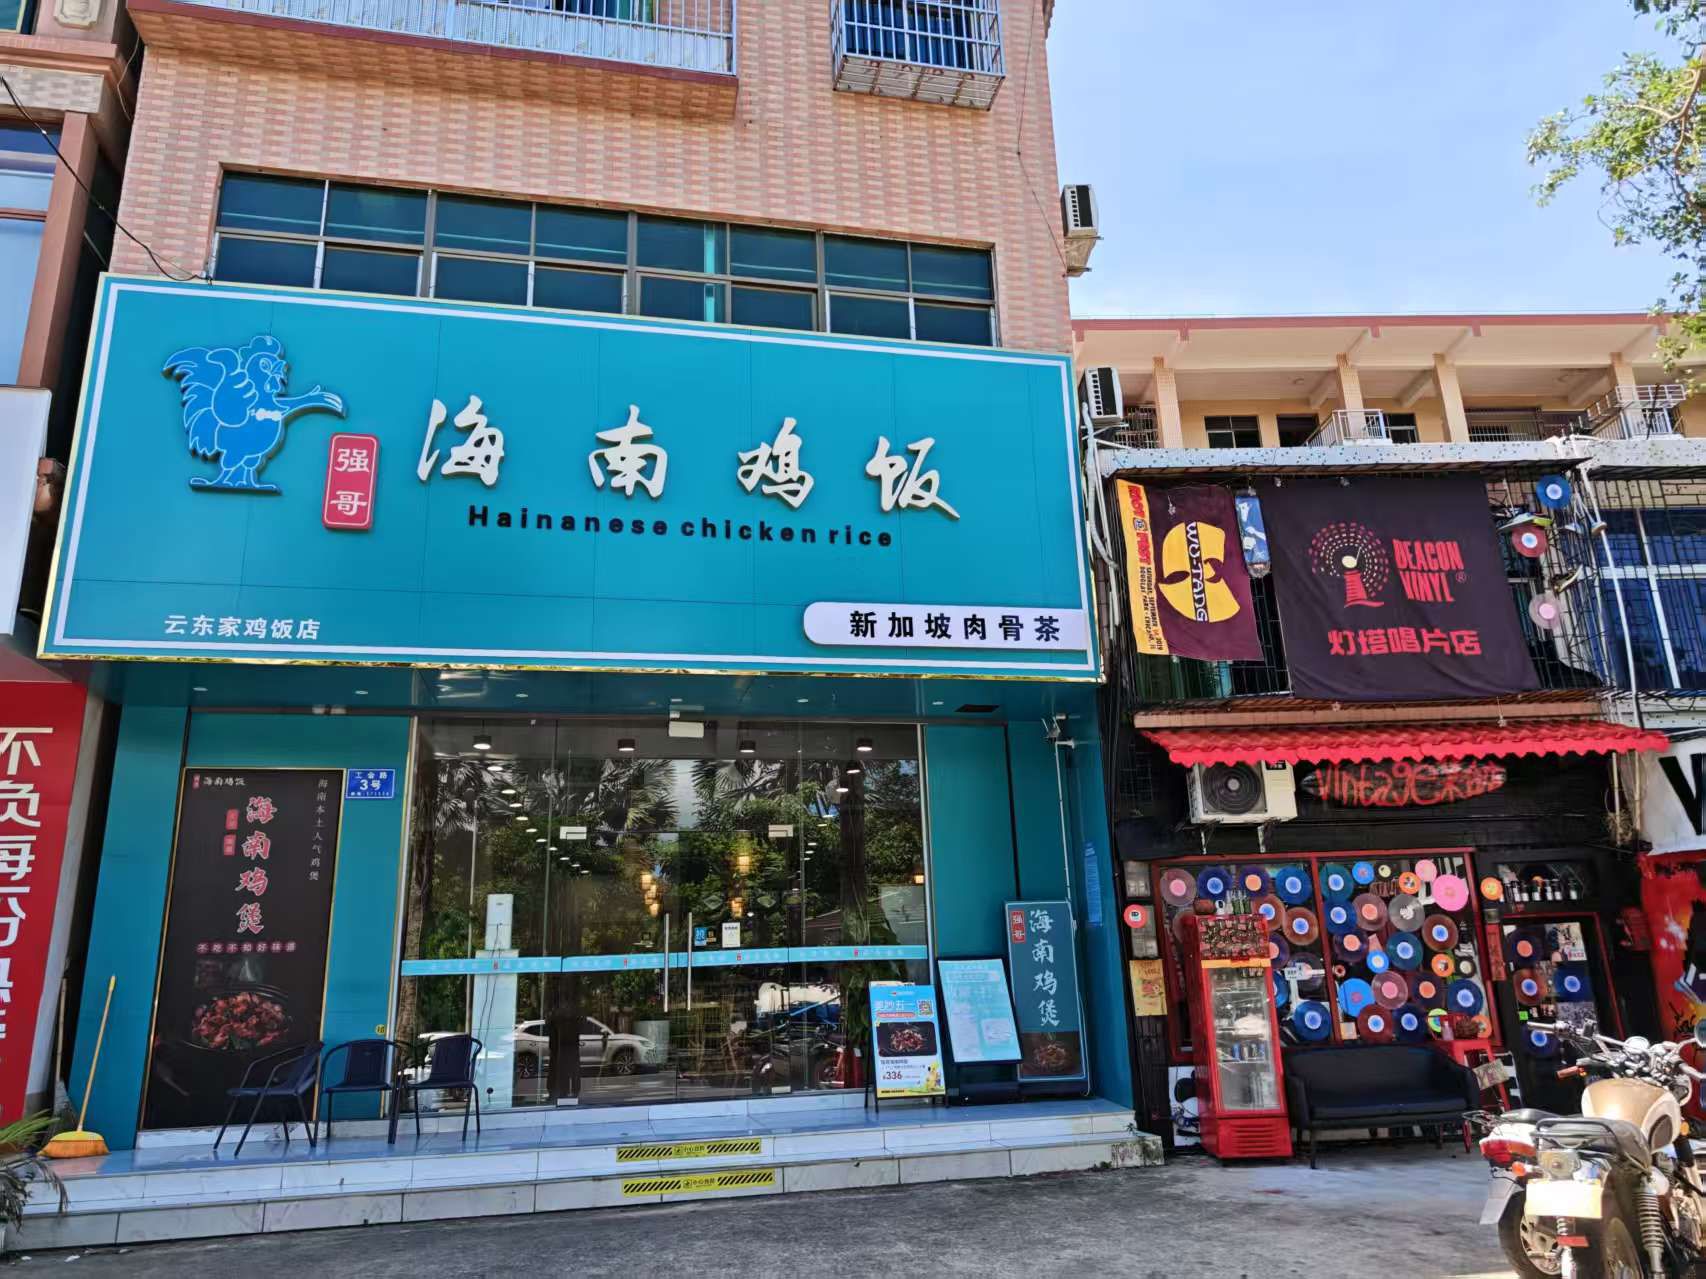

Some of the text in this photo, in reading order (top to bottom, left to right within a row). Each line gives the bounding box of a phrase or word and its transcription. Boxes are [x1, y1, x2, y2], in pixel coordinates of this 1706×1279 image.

[417, 395, 960, 521] 海南鸡饭
[330, 448, 370, 516] 强哥
[468, 505, 892, 547] Hainanese chicken rice
[1186, 522, 1208, 622] WU-TANG
[1392, 539, 1465, 571] BEACON
[1400, 571, 1455, 602] VINYL
[164, 614, 321, 640] 云东家鸡饭店
[849, 610, 1061, 642] 新加坡肉骨茶
[1327, 626, 1482, 656] 灯塔唱片店
[360, 779, 382, 790] 3号
[235, 796, 277, 934] 海南鸡煲
[1029, 909, 1060, 1027] 海南鸡煲
